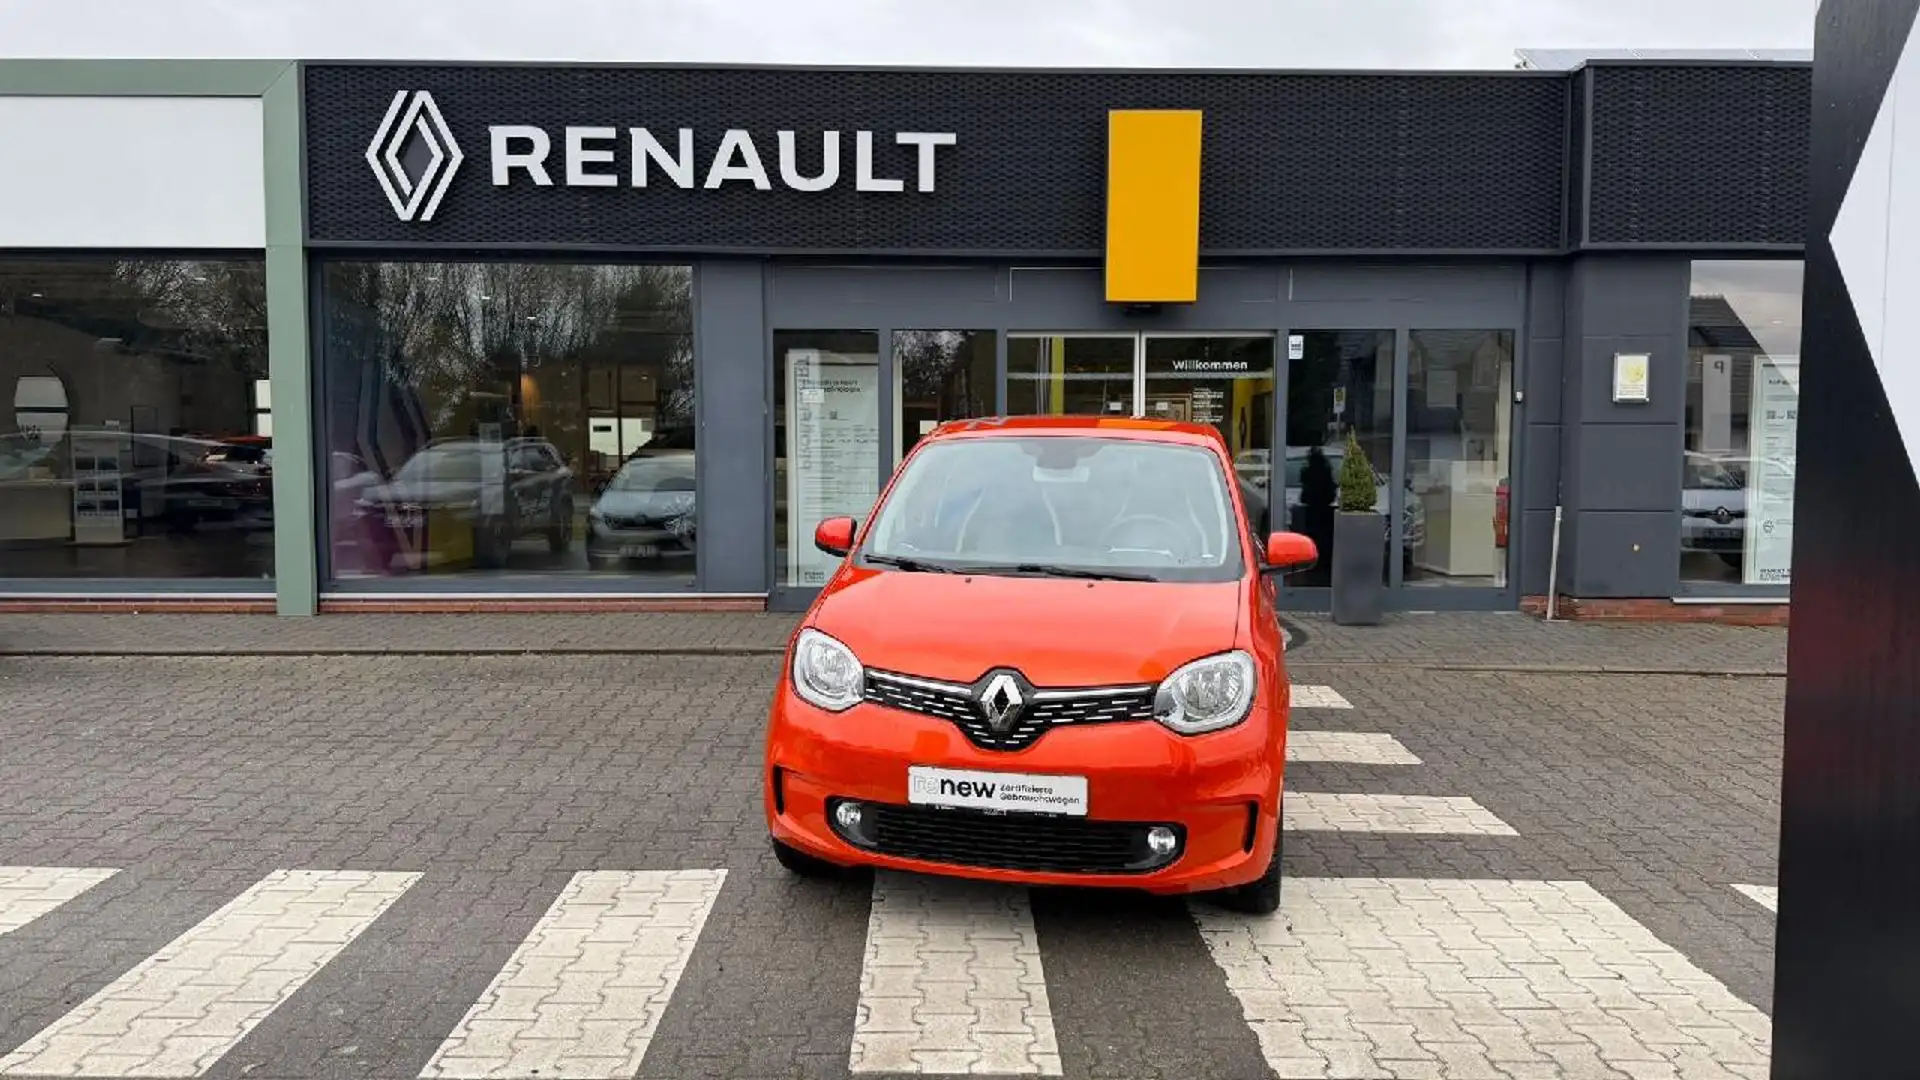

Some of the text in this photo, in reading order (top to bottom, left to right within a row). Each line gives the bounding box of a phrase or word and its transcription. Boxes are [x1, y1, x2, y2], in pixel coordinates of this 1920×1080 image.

[489, 125, 957, 192] RENAULT
[1172, 360, 1248, 370] Willkommen
[913, 775, 995, 798] renew
